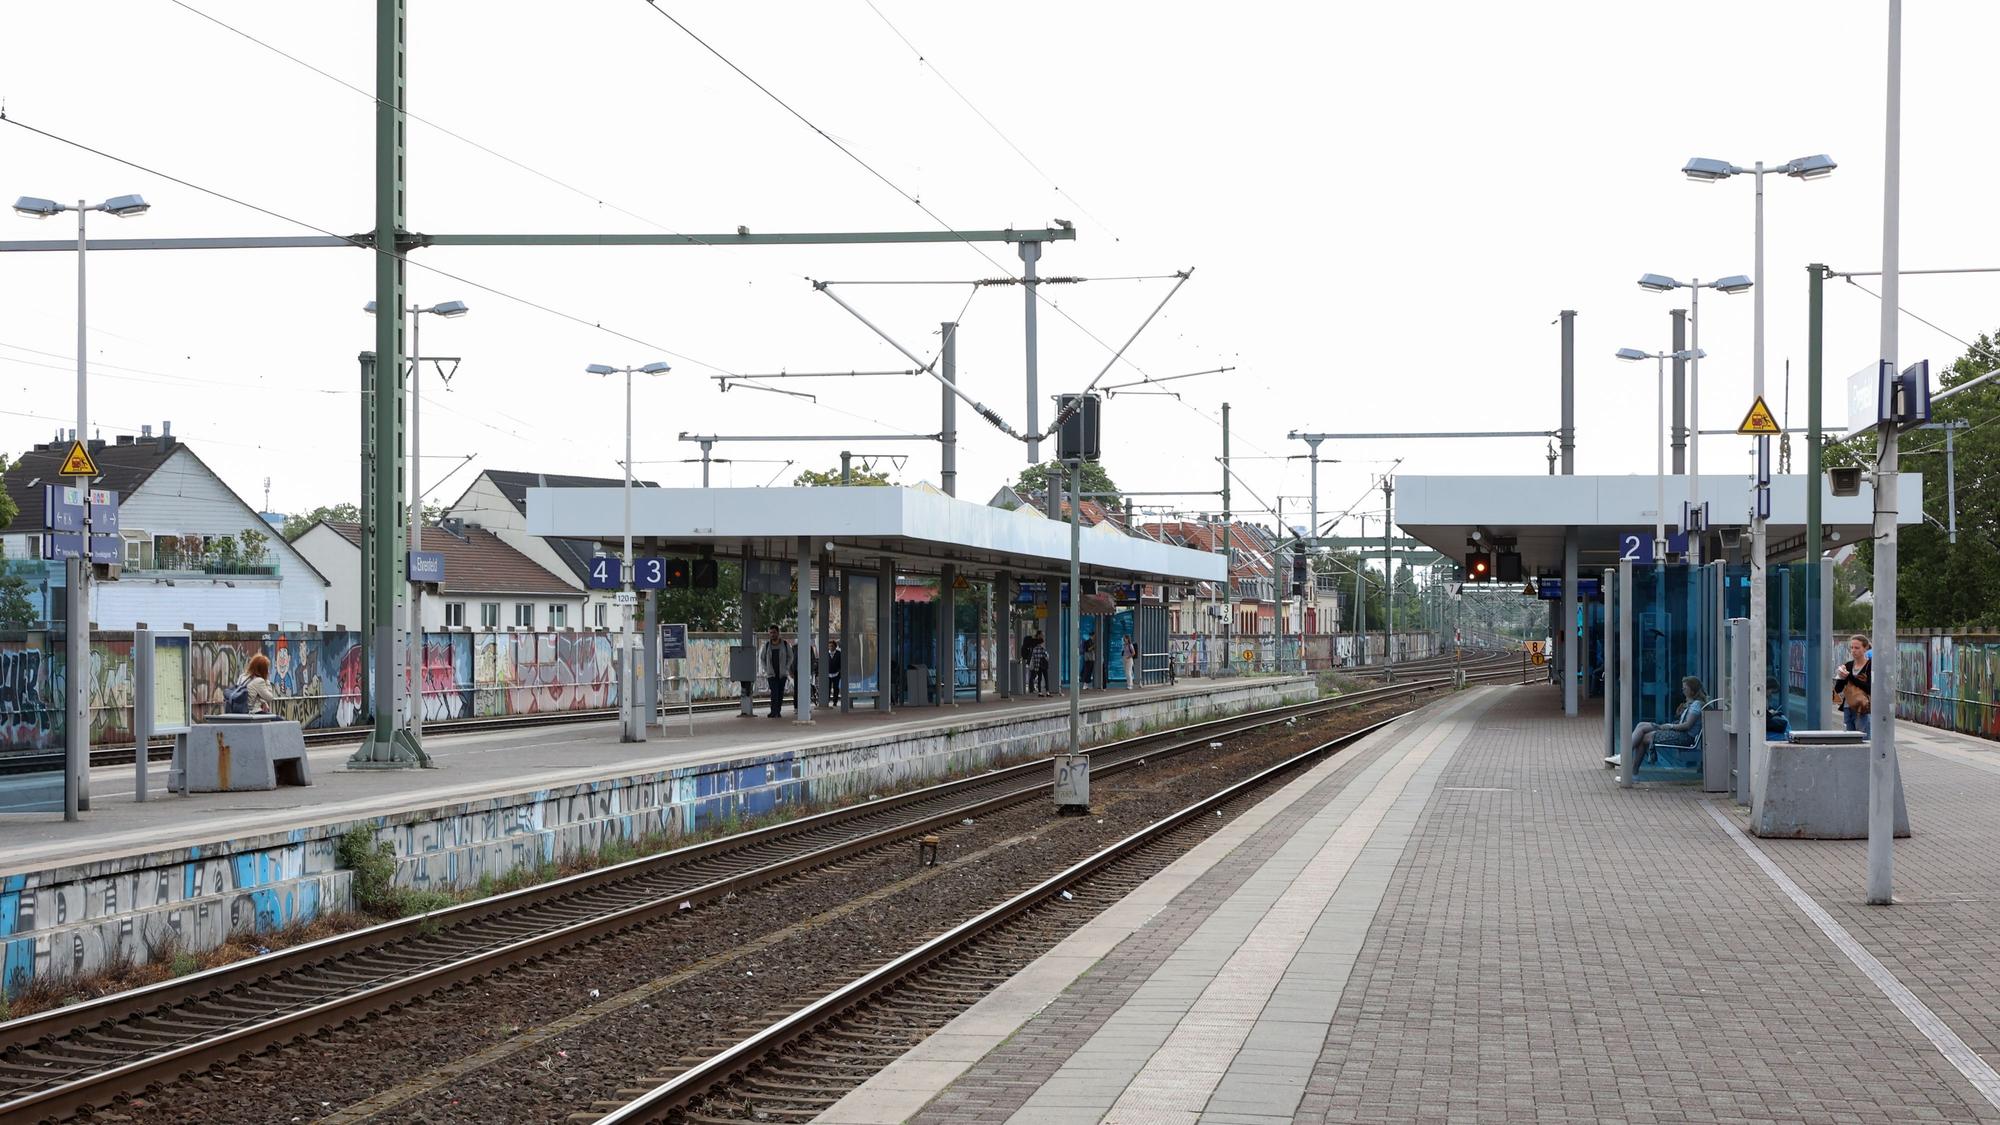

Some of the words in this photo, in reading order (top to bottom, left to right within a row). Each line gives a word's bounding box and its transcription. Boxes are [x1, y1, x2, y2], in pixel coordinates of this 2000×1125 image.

[1625, 536, 1640, 559] 2
[593, 560, 608, 583] 4
[646, 560, 661, 583] 3
[618, 594, 629, 602] 120
[1223, 605, 1229, 613] 3
[1223, 614, 1229, 622] 6
[1182, 641, 1190, 651] 12
[1532, 642, 1538, 652] 8
